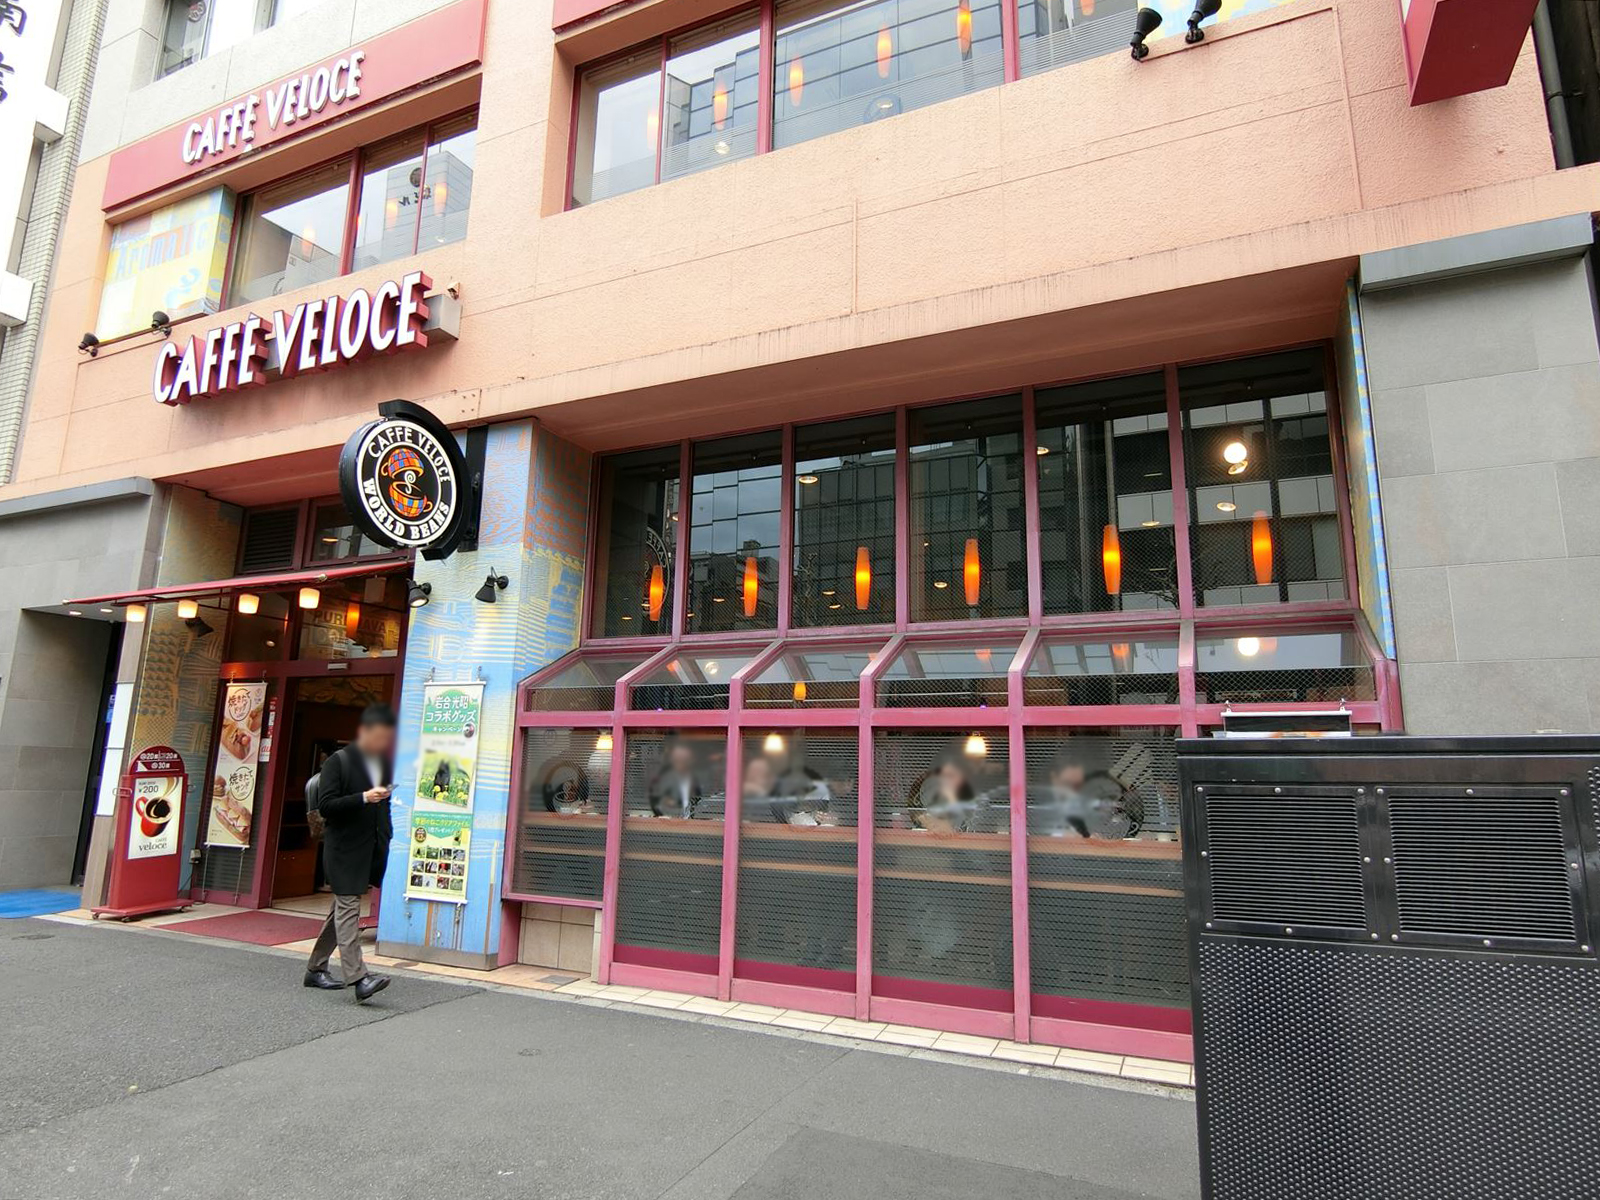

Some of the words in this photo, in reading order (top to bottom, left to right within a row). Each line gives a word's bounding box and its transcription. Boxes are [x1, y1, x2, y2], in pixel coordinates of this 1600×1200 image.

[266, 50, 365, 130] VELOCE
[274, 270, 430, 376] VELOCE
[368, 426, 413, 458] CAFFE
[418, 432, 451, 482] VELOCE
[363, 477, 406, 537] WORLD
[410, 501, 450, 539] BEANS
[426, 709, 476, 723] コラボグッズ
[435, 695, 469, 710] 岩合光昭
[230, 768, 254, 786] 焼きたて
[138, 842, 167, 852] veloce
